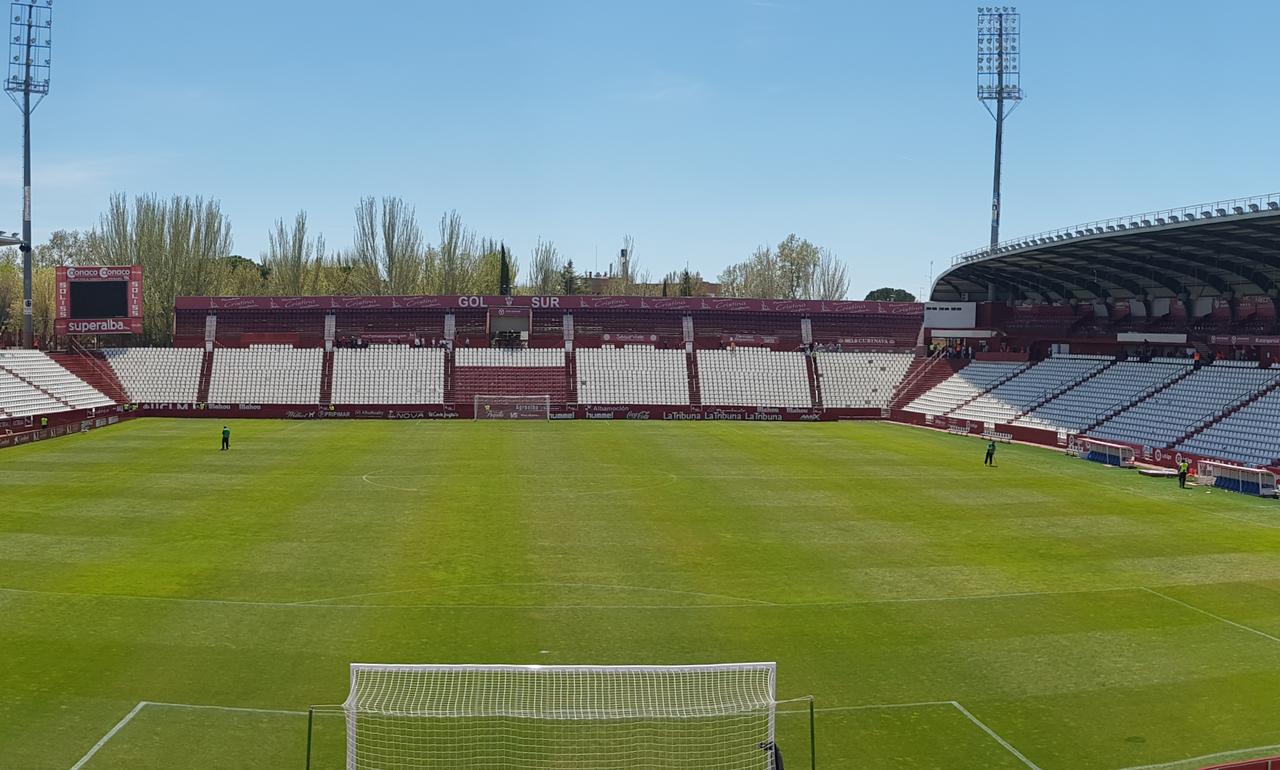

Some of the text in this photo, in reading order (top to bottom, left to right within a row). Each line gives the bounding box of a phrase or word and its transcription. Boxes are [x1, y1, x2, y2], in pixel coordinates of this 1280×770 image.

[458, 296, 560, 308] GOL SUR
[68, 319, 124, 332] superalba
